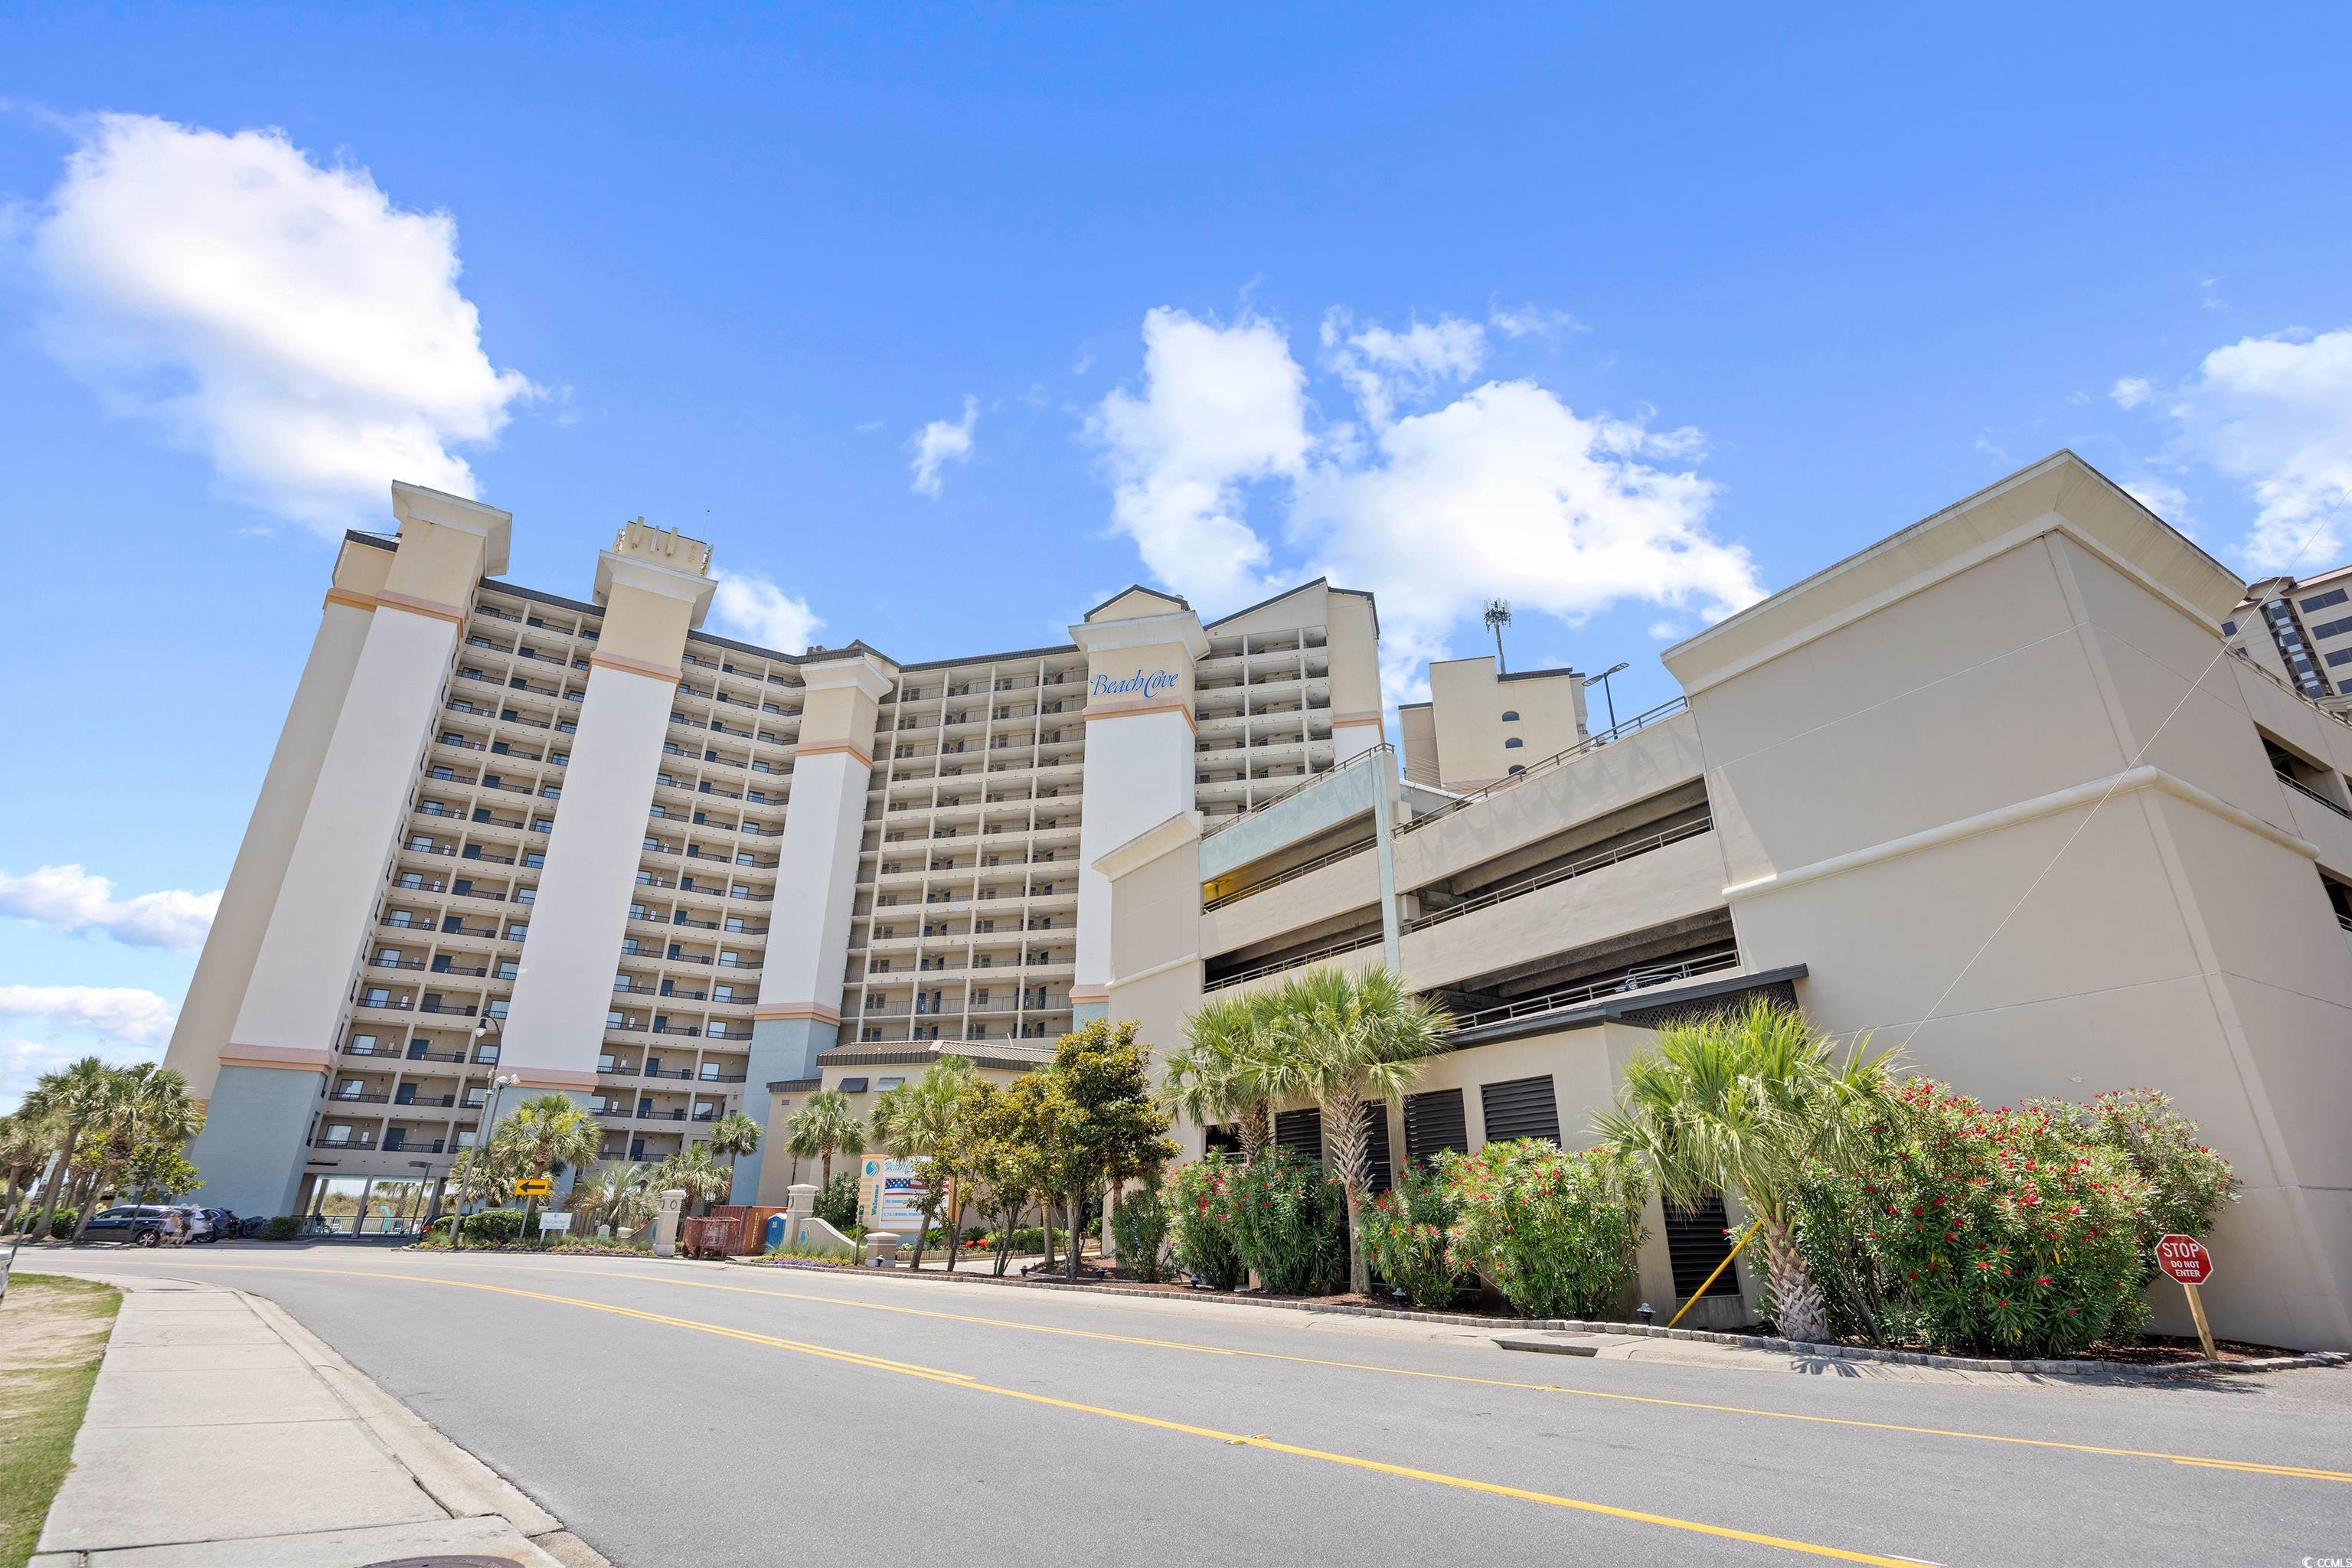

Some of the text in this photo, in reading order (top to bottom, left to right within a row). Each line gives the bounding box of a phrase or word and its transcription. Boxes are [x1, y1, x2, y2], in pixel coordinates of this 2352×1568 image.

[1090, 668, 1179, 698] Beach Cove
[871, 1184, 880, 1216] Welcome
[2161, 1242, 2199, 1258] STOP
[2184, 1260, 2200, 1269] NOT
[2175, 1269, 2201, 1278] ENTER
